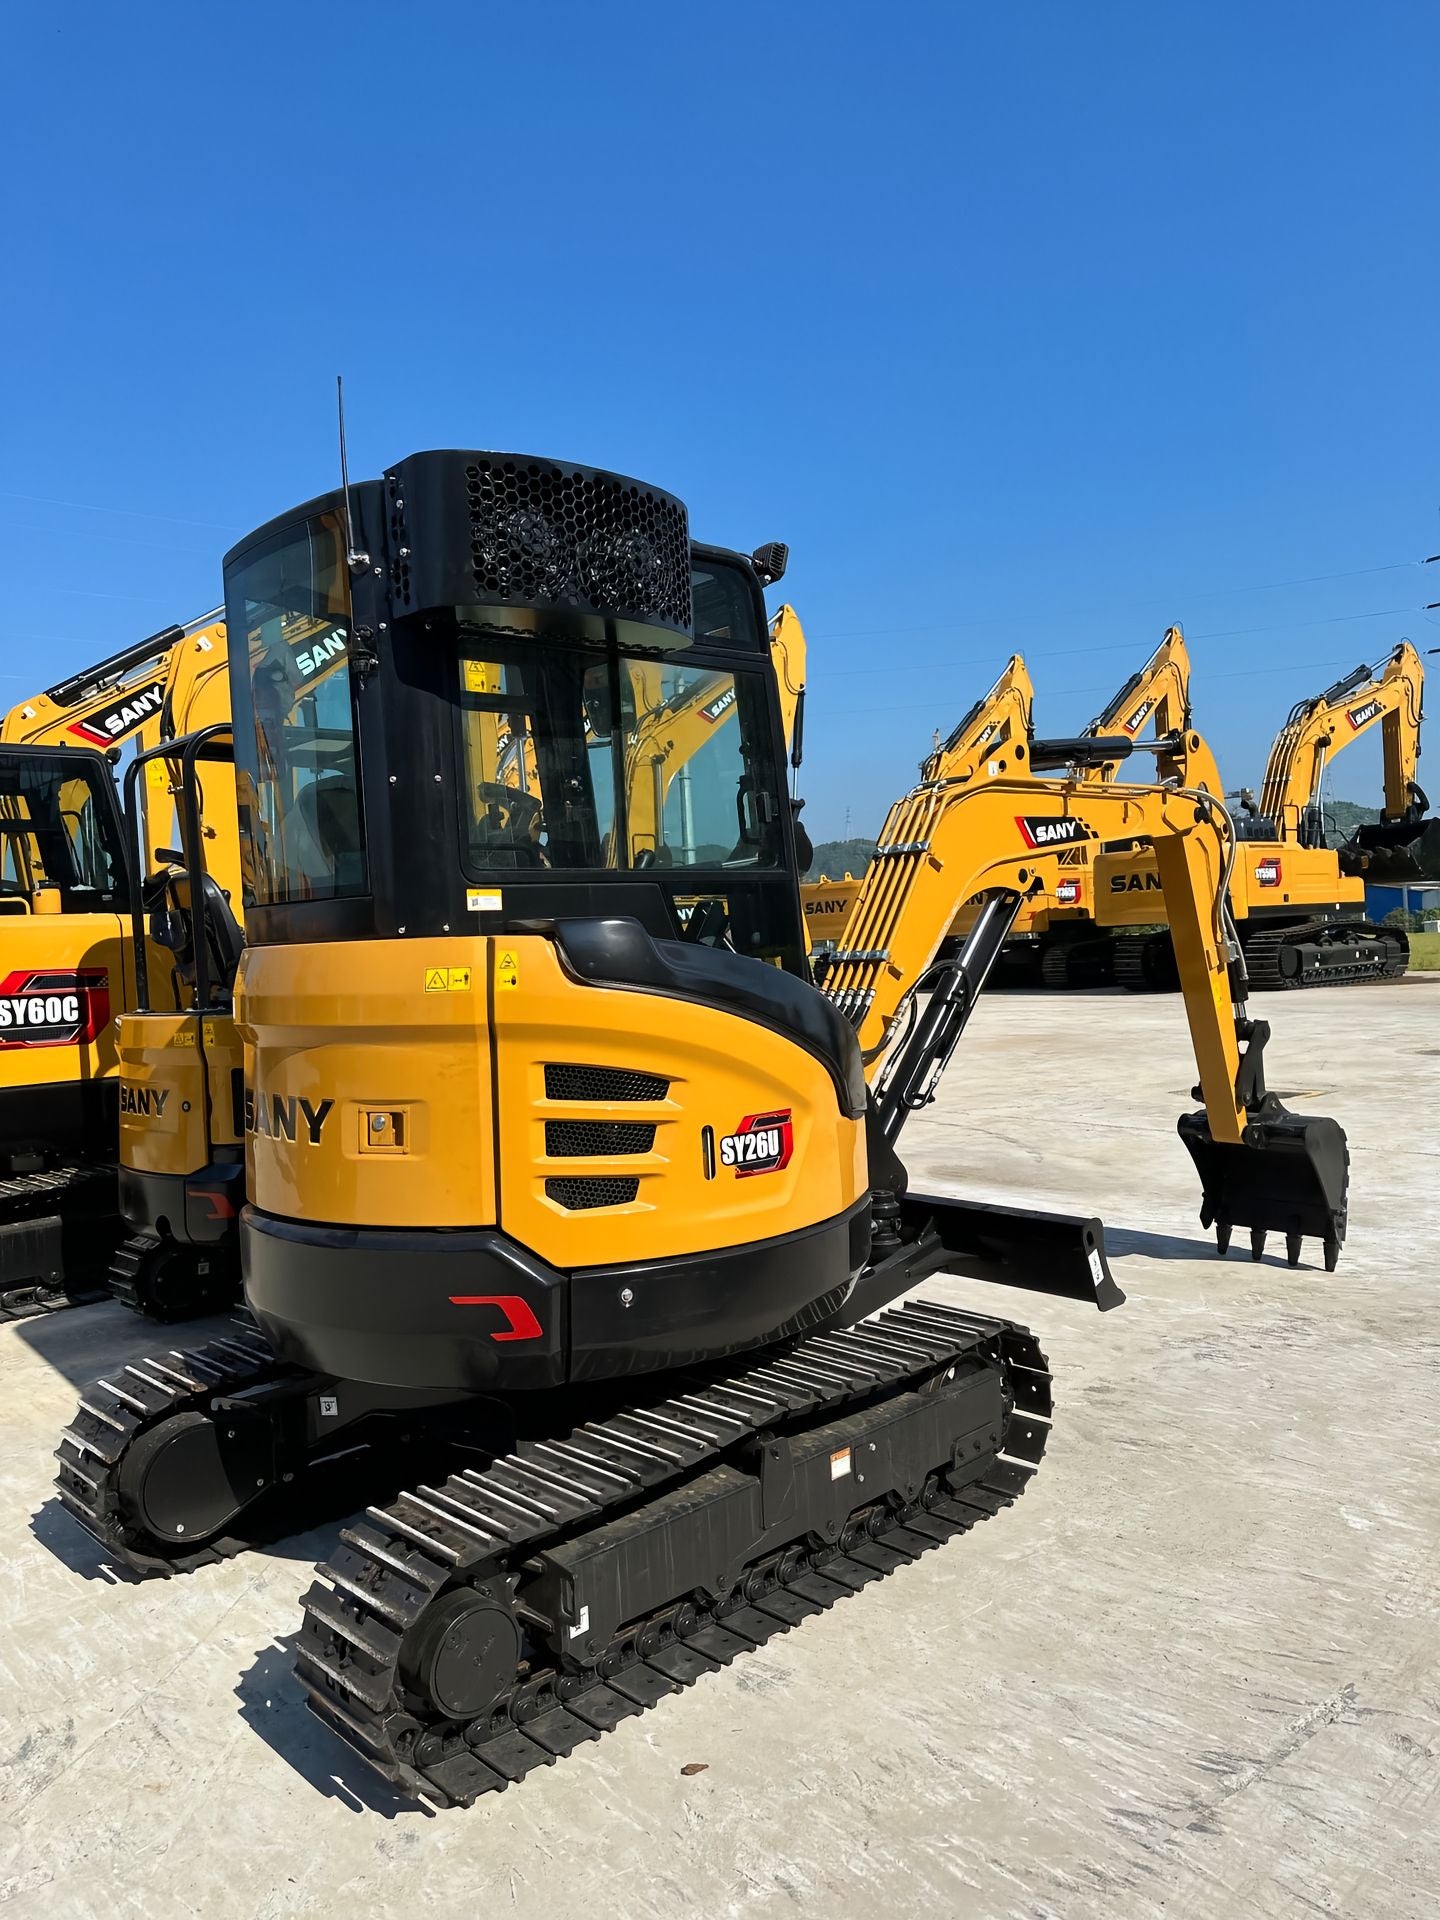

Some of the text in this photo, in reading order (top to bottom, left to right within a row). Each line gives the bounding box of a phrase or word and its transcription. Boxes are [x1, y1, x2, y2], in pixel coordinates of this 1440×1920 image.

[104, 685, 163, 735] SANY
[711, 687, 736, 717] SANY
[1131, 703, 1150, 728] SANY
[1355, 703, 1376, 725] SANY
[1036, 821, 1077, 843] SANY
[805, 900, 848, 915] SANY
[0, 995, 79, 1027] SY60C
[720, 1128, 780, 1166] SY26U
